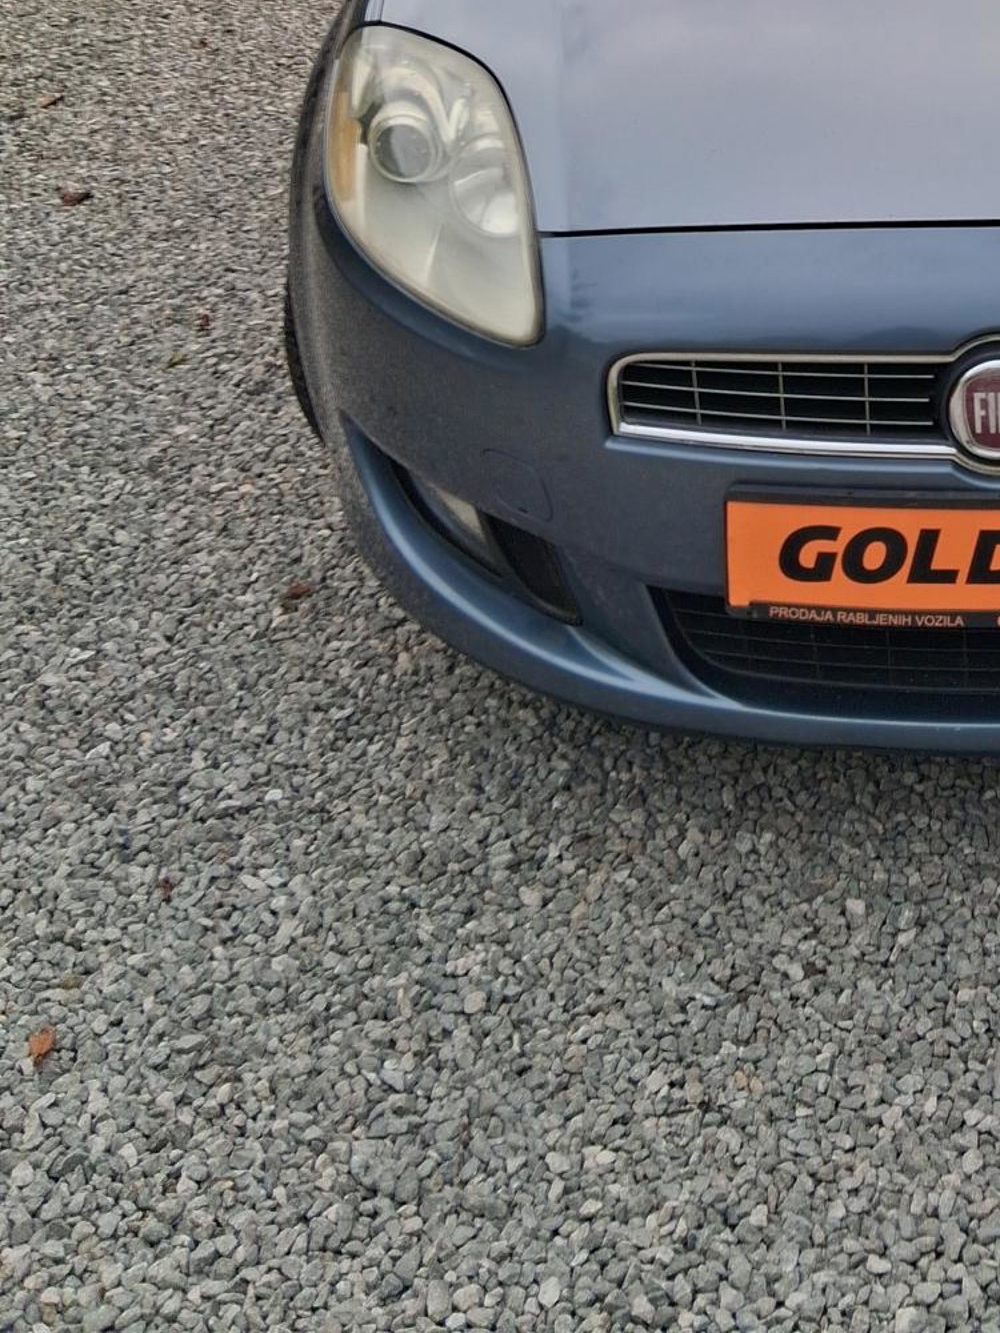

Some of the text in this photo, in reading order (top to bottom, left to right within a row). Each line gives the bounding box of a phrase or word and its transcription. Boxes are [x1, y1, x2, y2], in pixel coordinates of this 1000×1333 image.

[768, 606, 965, 627] PRODAJA RABLJENIH VOZILA
